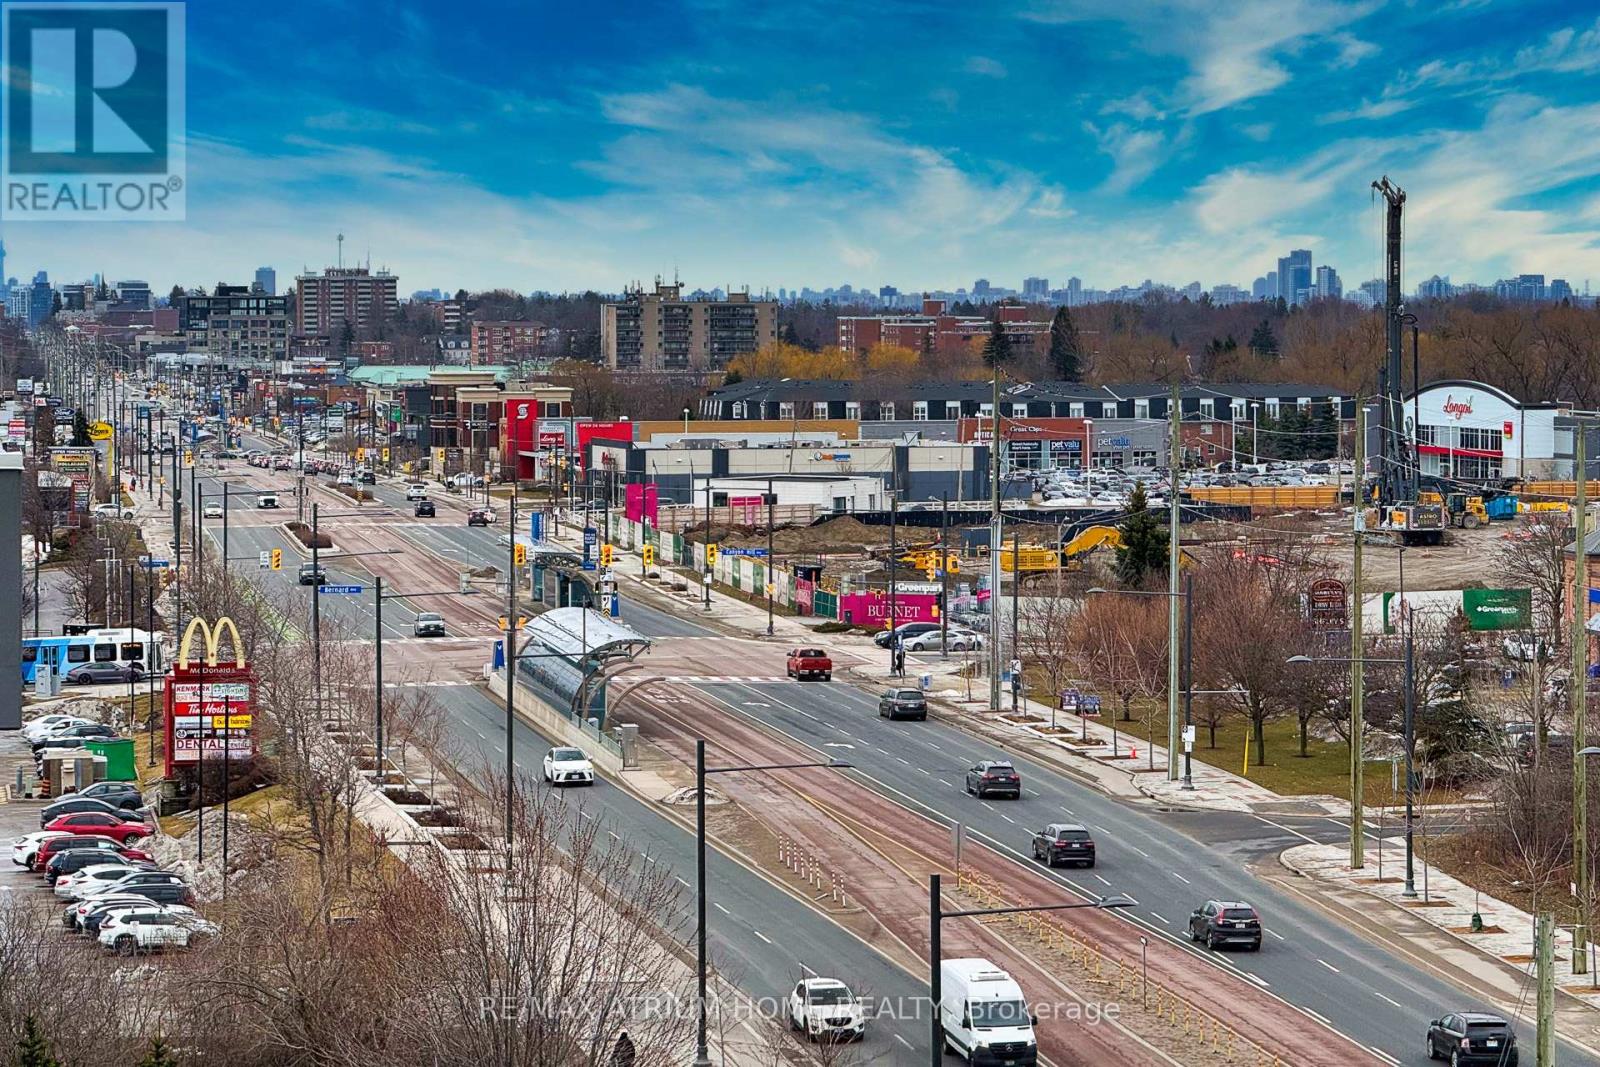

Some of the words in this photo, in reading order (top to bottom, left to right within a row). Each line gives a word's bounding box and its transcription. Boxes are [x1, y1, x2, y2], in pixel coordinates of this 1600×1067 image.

[1051, 440, 1064, 450] pet
[1064, 440, 1080, 448] valu
[1097, 437, 1112, 449] pet
[867, 605, 921, 618] BURNET
[176, 739, 225, 749] DENTAL
